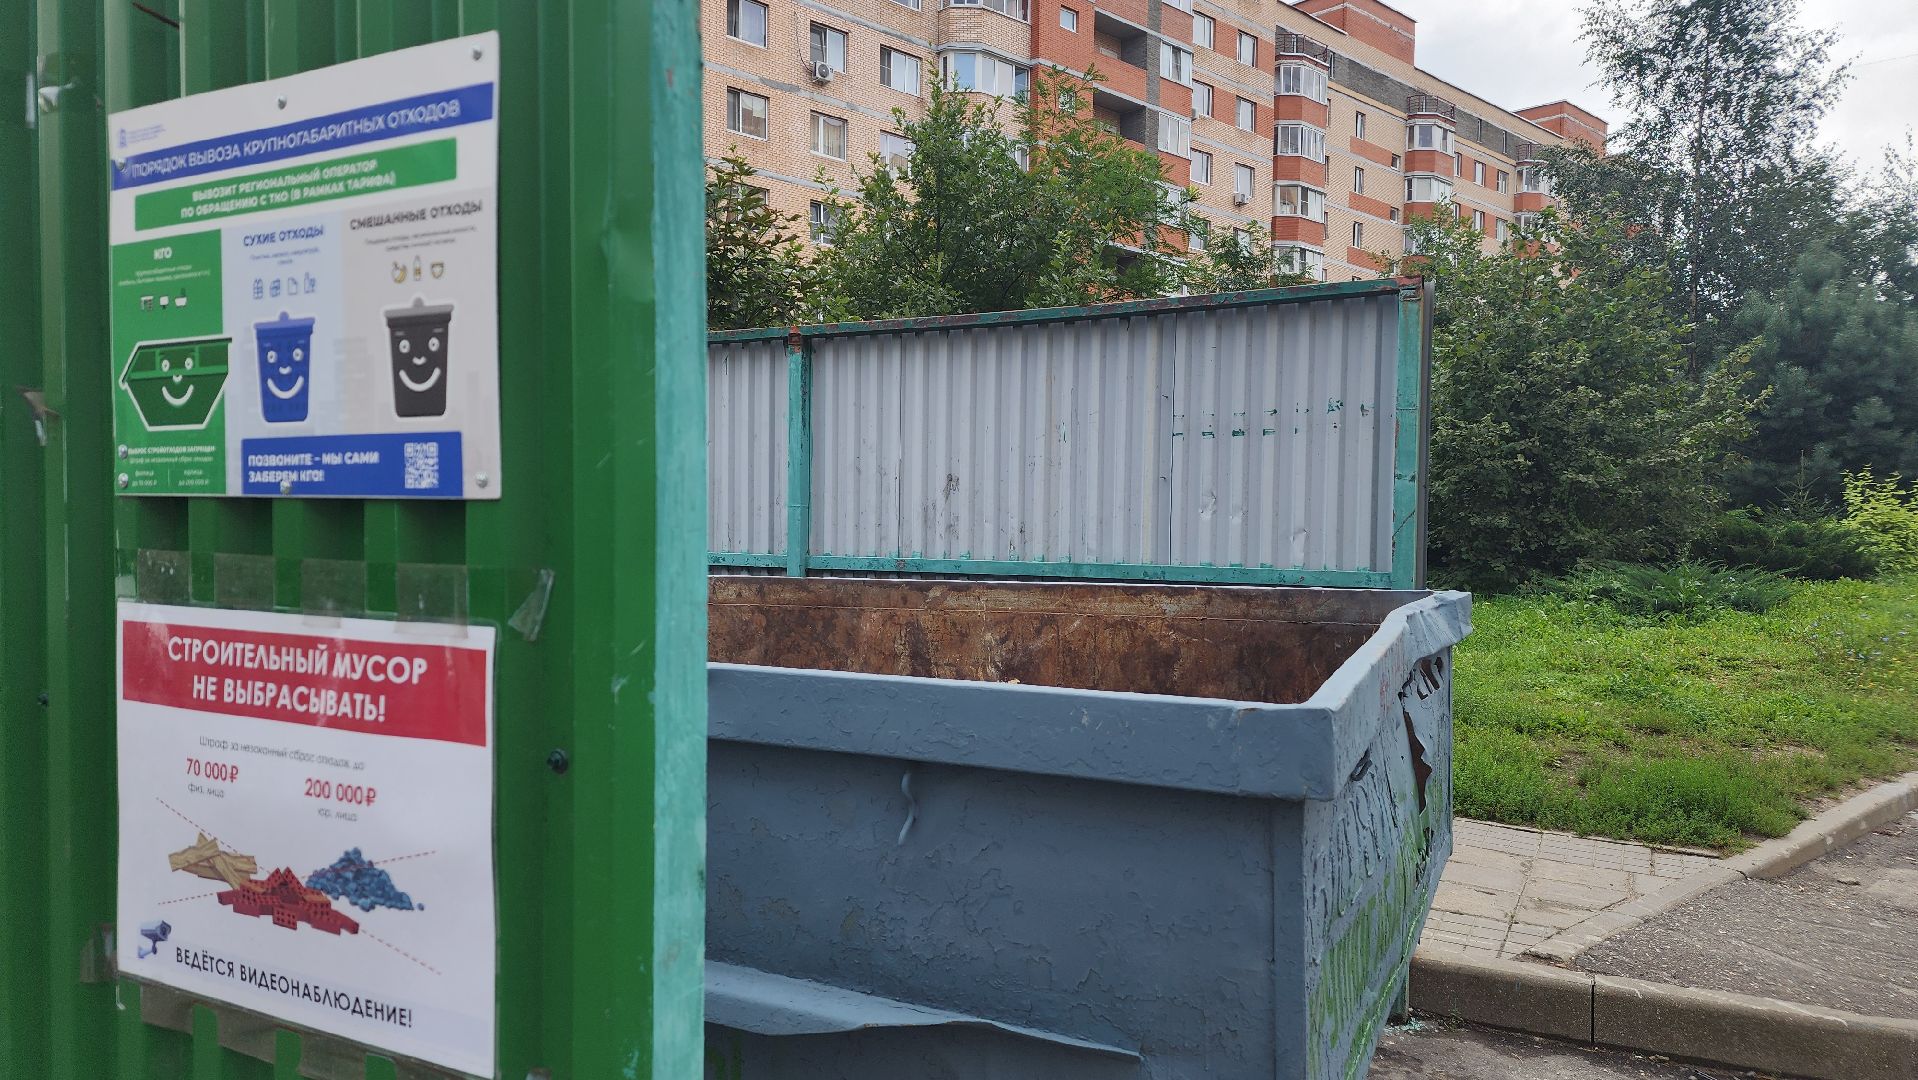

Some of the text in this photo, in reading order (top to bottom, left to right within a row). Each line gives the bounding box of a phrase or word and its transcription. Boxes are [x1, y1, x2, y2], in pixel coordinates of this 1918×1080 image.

[131, 99, 461, 178] ПОРЯДОК ВЫВОЗА КРУПНОГАБАРИТНЫХ ОТХОДОВ
[180, 206, 194, 219] ПО
[195, 195, 258, 216] ОБРАЩЕНИЮ
[259, 193, 267, 206] С
[269, 190, 288, 205] ТКО
[303, 180, 344, 198] РАМКАХ
[347, 170, 396, 191] ТАРИФА)
[192, 159, 378, 201] ВЫВОЗИТ РЕГИОНАЛЬНЫЙ ОПЕРАТОР
[350, 200, 483, 230] СМЕШАННЫЕ ОТХОДЫ
[243, 225, 324, 247] СУХИЕ ОТХОДЫ
[248, 453, 313, 467] ПОЗВОНИТЕ
[321, 451, 343, 465] МЫ
[344, 451, 380, 464] САМИ
[248, 469, 325, 483] ЗАБЕРЕМ КГО!
[168, 636, 428, 685] СТРОИТЕЛЬНЫЙ МУСОР
[193, 674, 386, 722] НЕ ВЫБРАСЫВАТЬ!
[200, 735, 228, 751] Штраф
[240, 744, 288, 758] незаконный
[186, 758, 201, 776] 70
[304, 777, 331, 799] 200
[176, 947, 413, 1028] ВЕДЁТСЯ ВИДЕОНАБЛЮДЕНИЕ!
